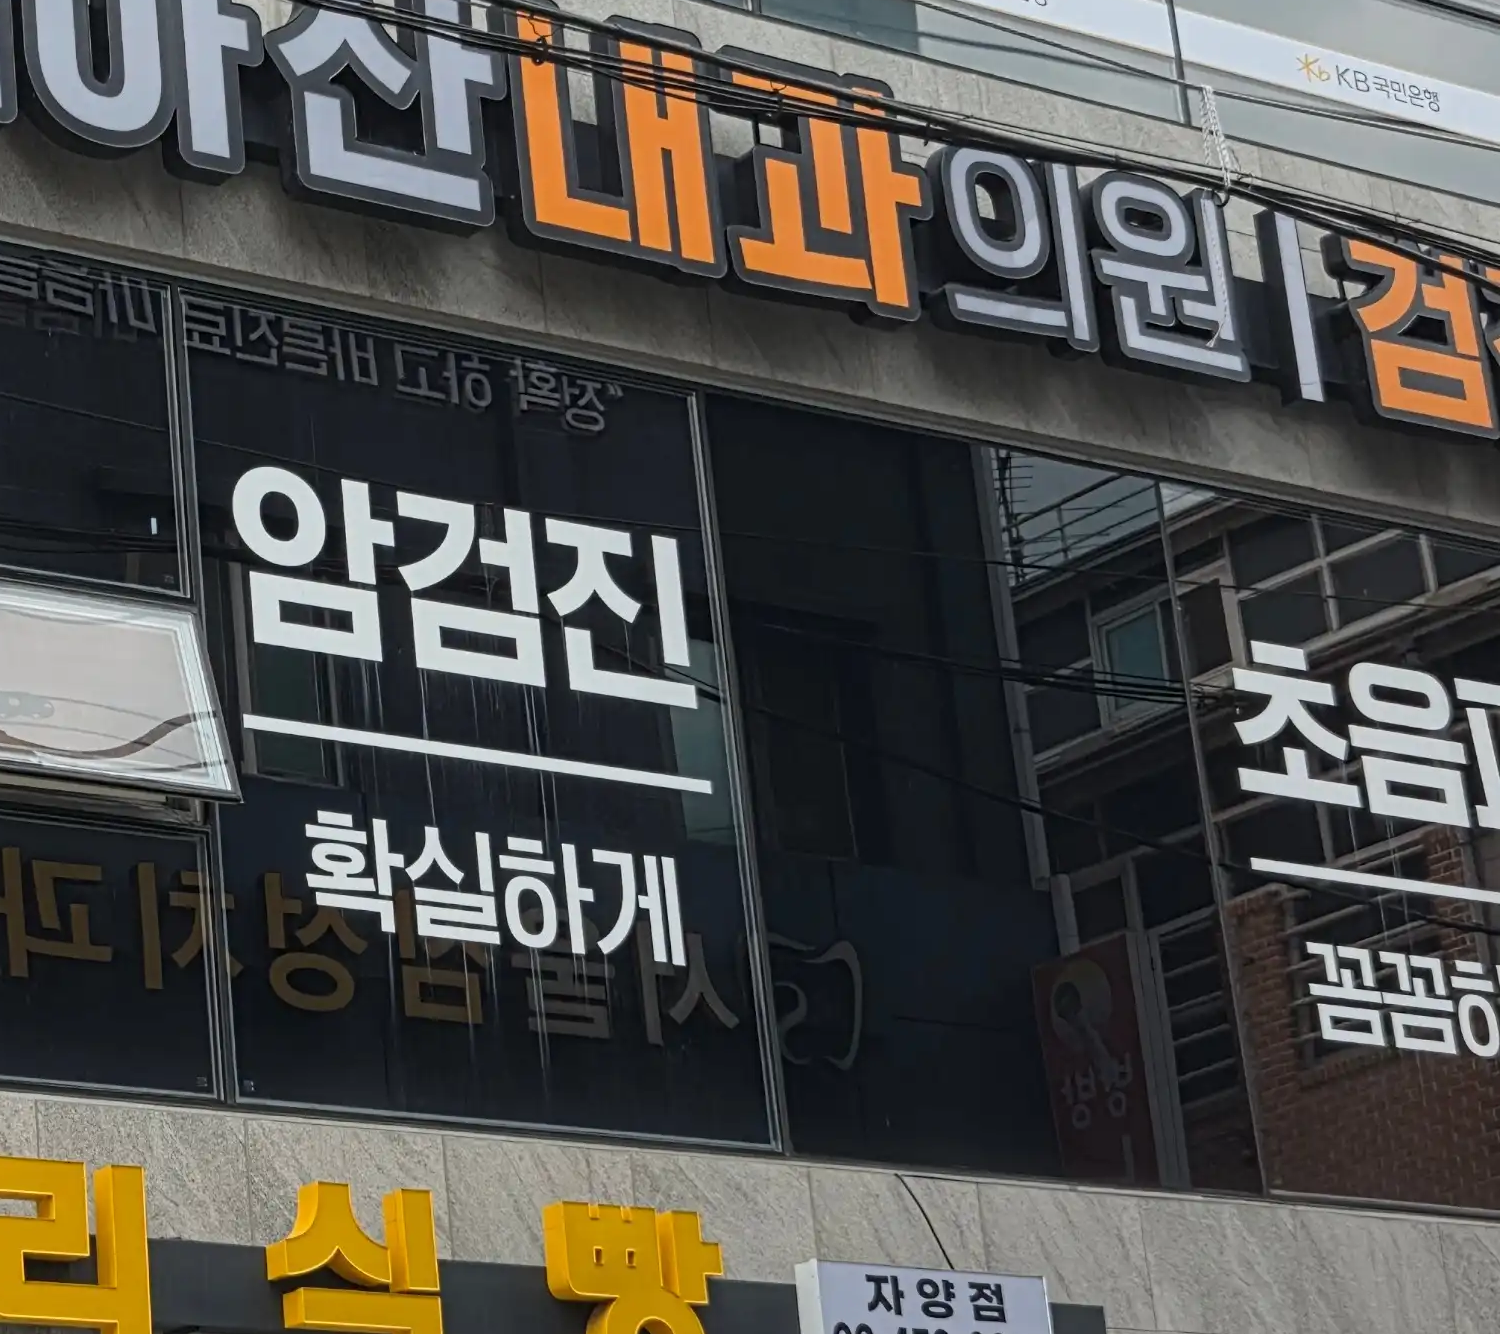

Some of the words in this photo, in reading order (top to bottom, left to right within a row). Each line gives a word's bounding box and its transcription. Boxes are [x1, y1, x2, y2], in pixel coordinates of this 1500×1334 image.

[1335, 64, 1441, 113] KB국민은행
[1342, 233, 1500, 437] 검
[230, 465, 699, 711] 암검진
[303, 806, 688, 966] 확실하게
[864, 1272, 1008, 1324] 자양점
